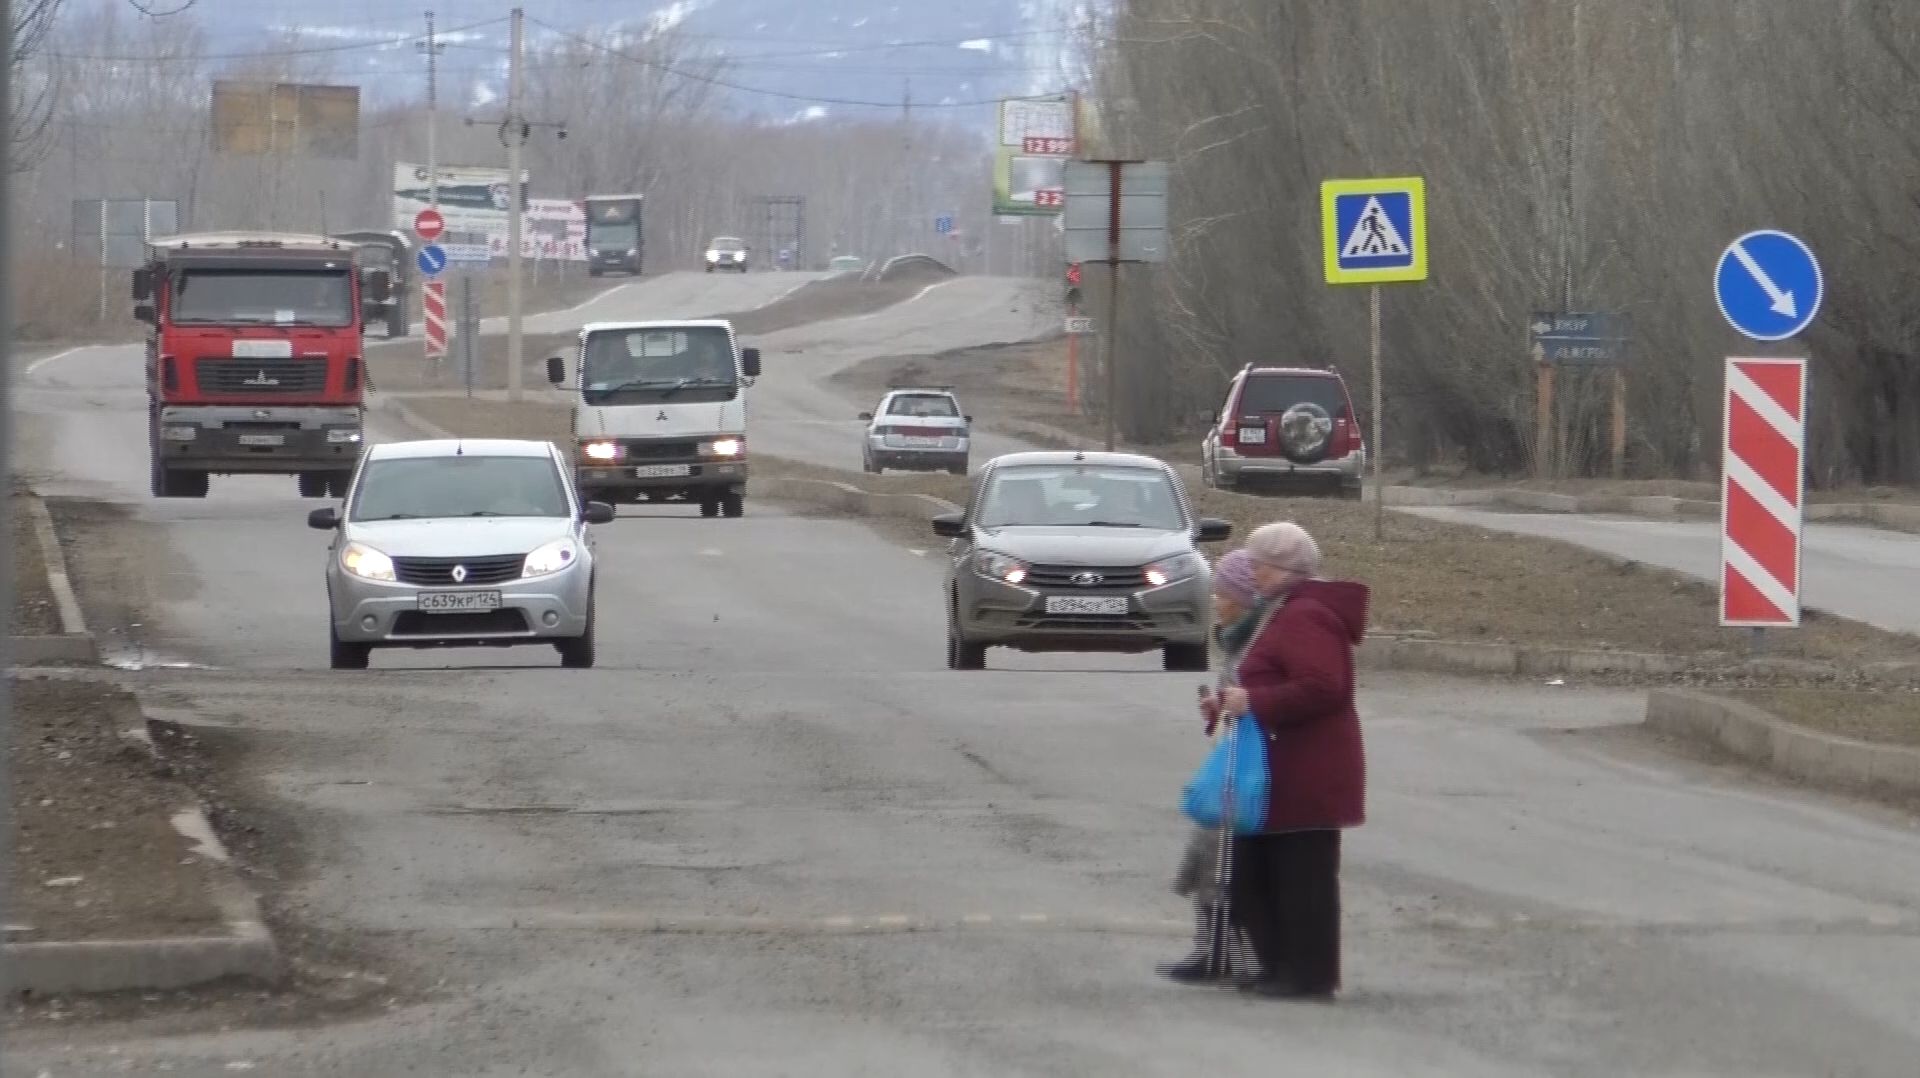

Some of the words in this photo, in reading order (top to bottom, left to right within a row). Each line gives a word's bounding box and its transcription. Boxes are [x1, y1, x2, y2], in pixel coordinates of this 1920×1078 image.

[422, 594, 473, 608] С639КР
[478, 593, 497, 604] 124
[1050, 598, 1103, 611] Е094ОУ
